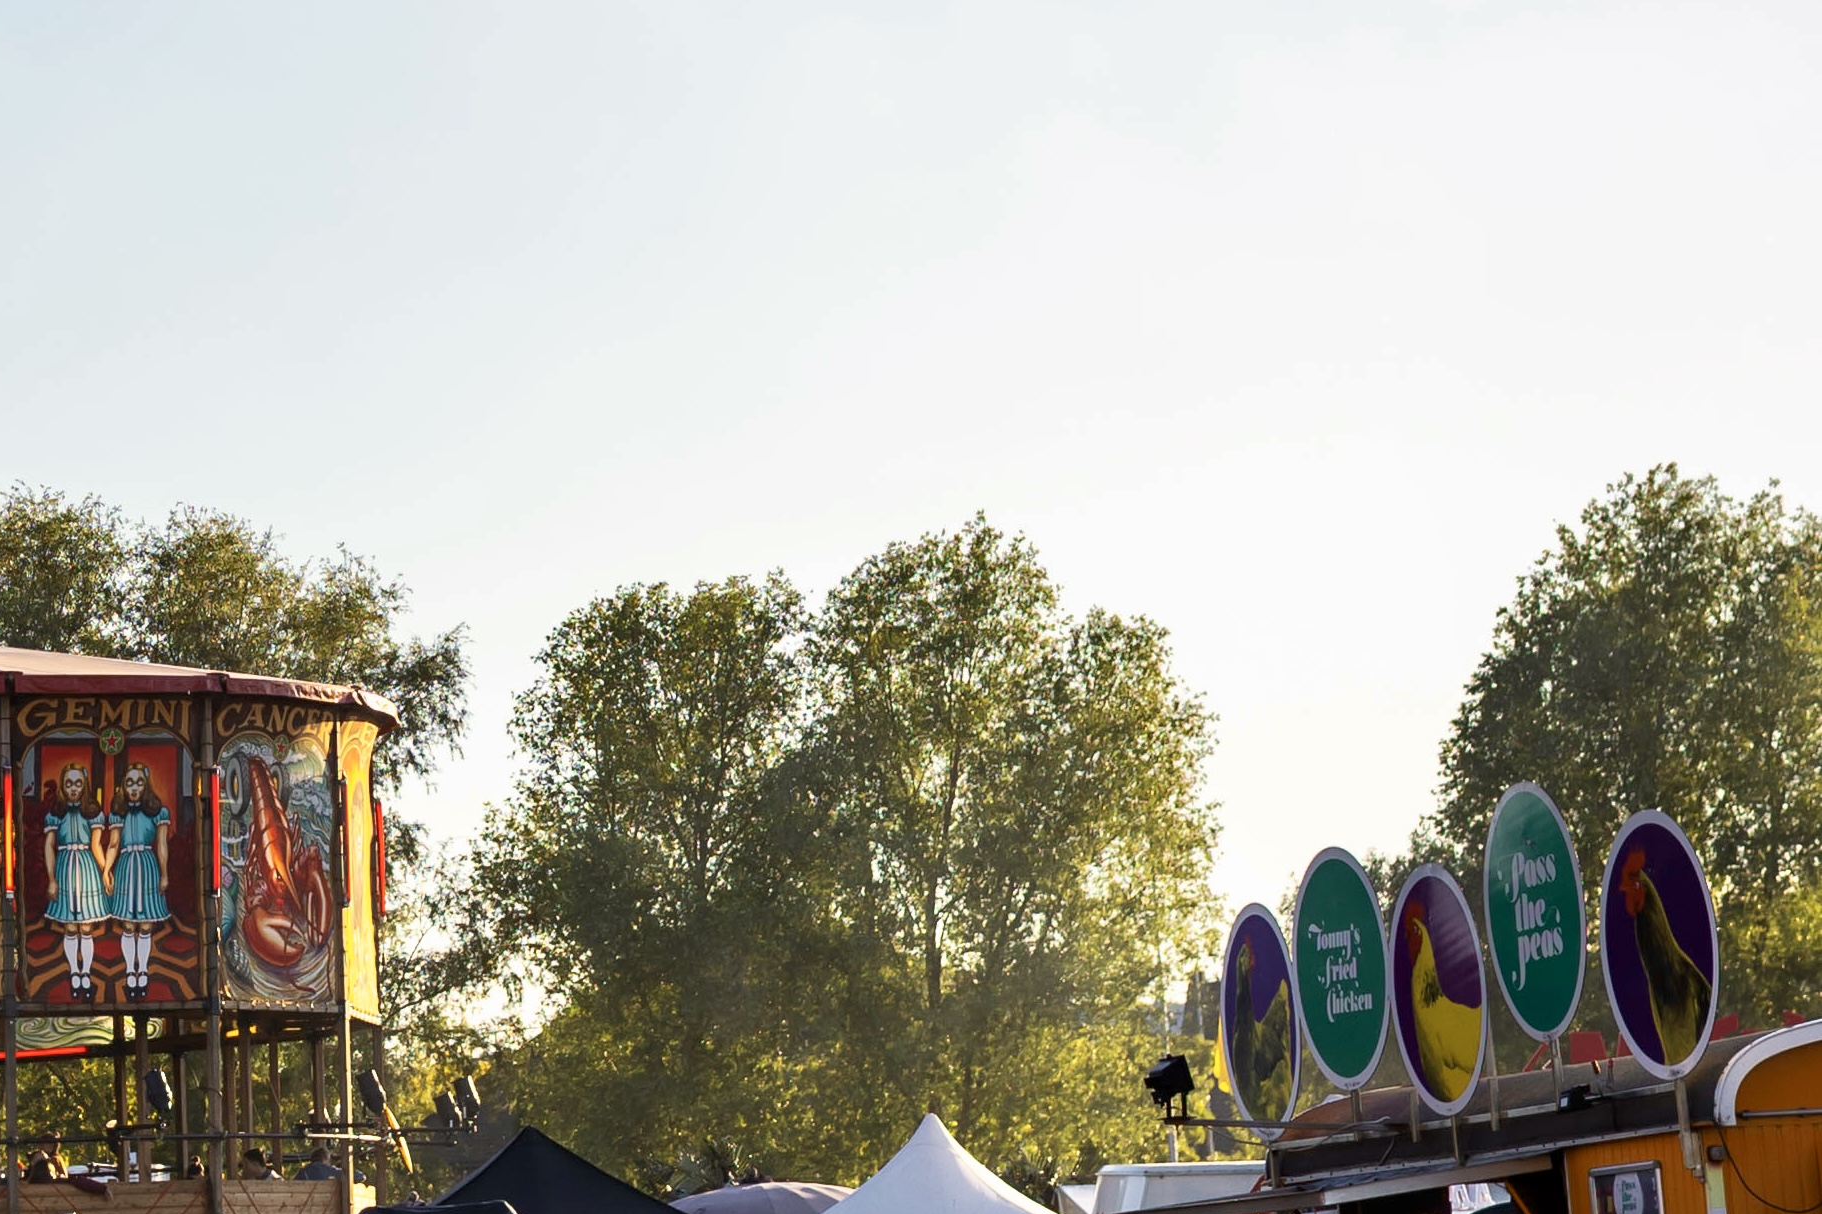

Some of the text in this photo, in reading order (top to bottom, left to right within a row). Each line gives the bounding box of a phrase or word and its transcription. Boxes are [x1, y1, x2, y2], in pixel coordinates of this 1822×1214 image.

[17, 697, 192, 741] GEMINI
[216, 703, 334, 748] CANCER
[1498, 851, 1557, 903] Pass
[1515, 893, 1548, 932] the
[1512, 927, 1564, 991] peas
